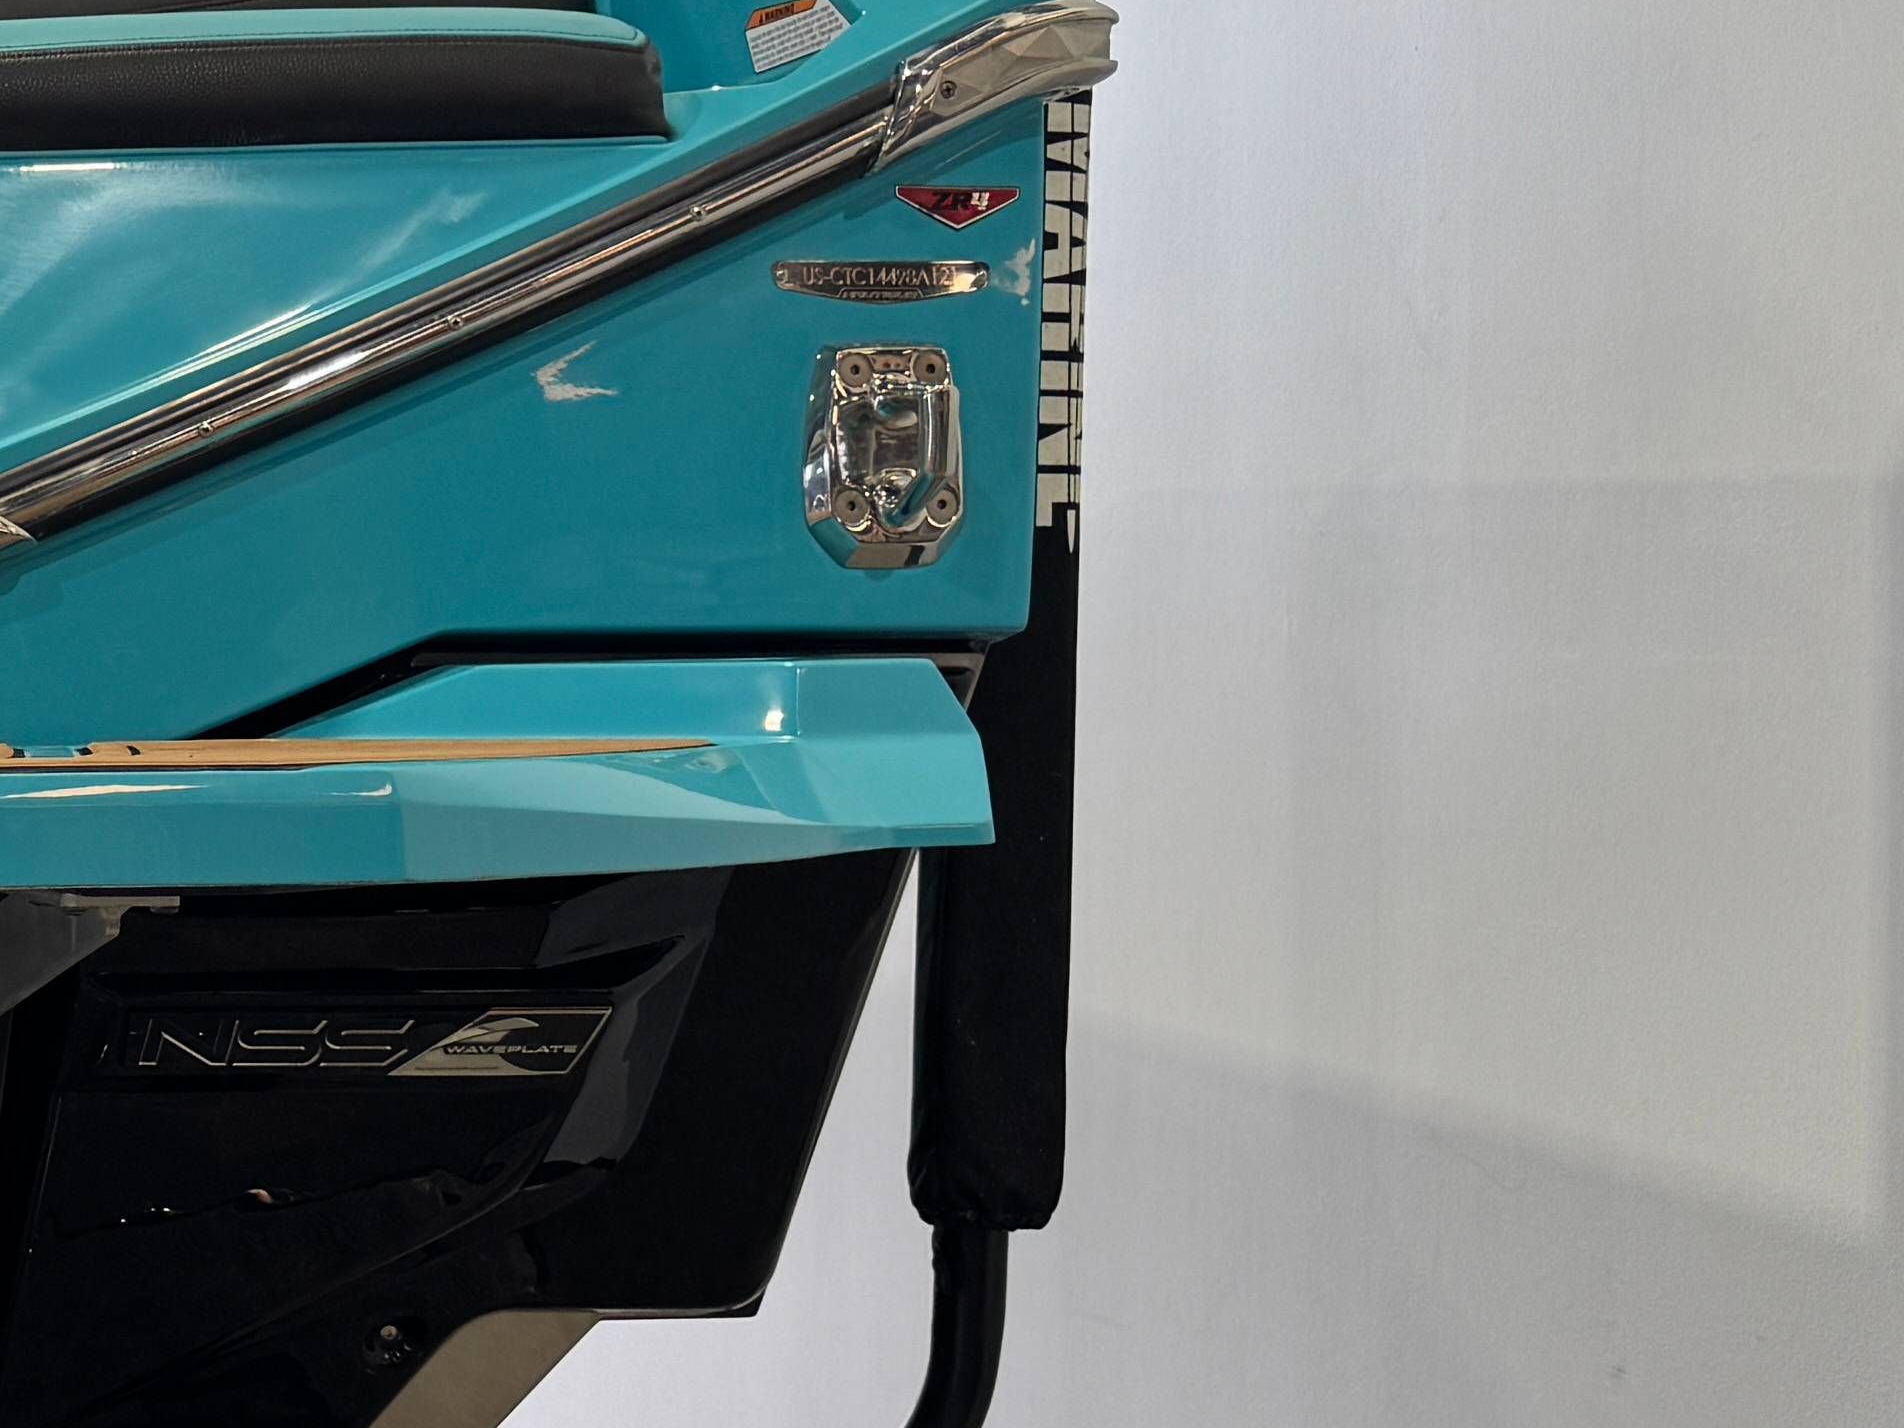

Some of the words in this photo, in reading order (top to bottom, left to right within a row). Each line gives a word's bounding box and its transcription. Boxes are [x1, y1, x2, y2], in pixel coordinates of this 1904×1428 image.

[931, 190, 990, 212] ZR4
[138, 1018, 416, 1067] NSS
[446, 1043, 579, 1054] WAVEPLATE
